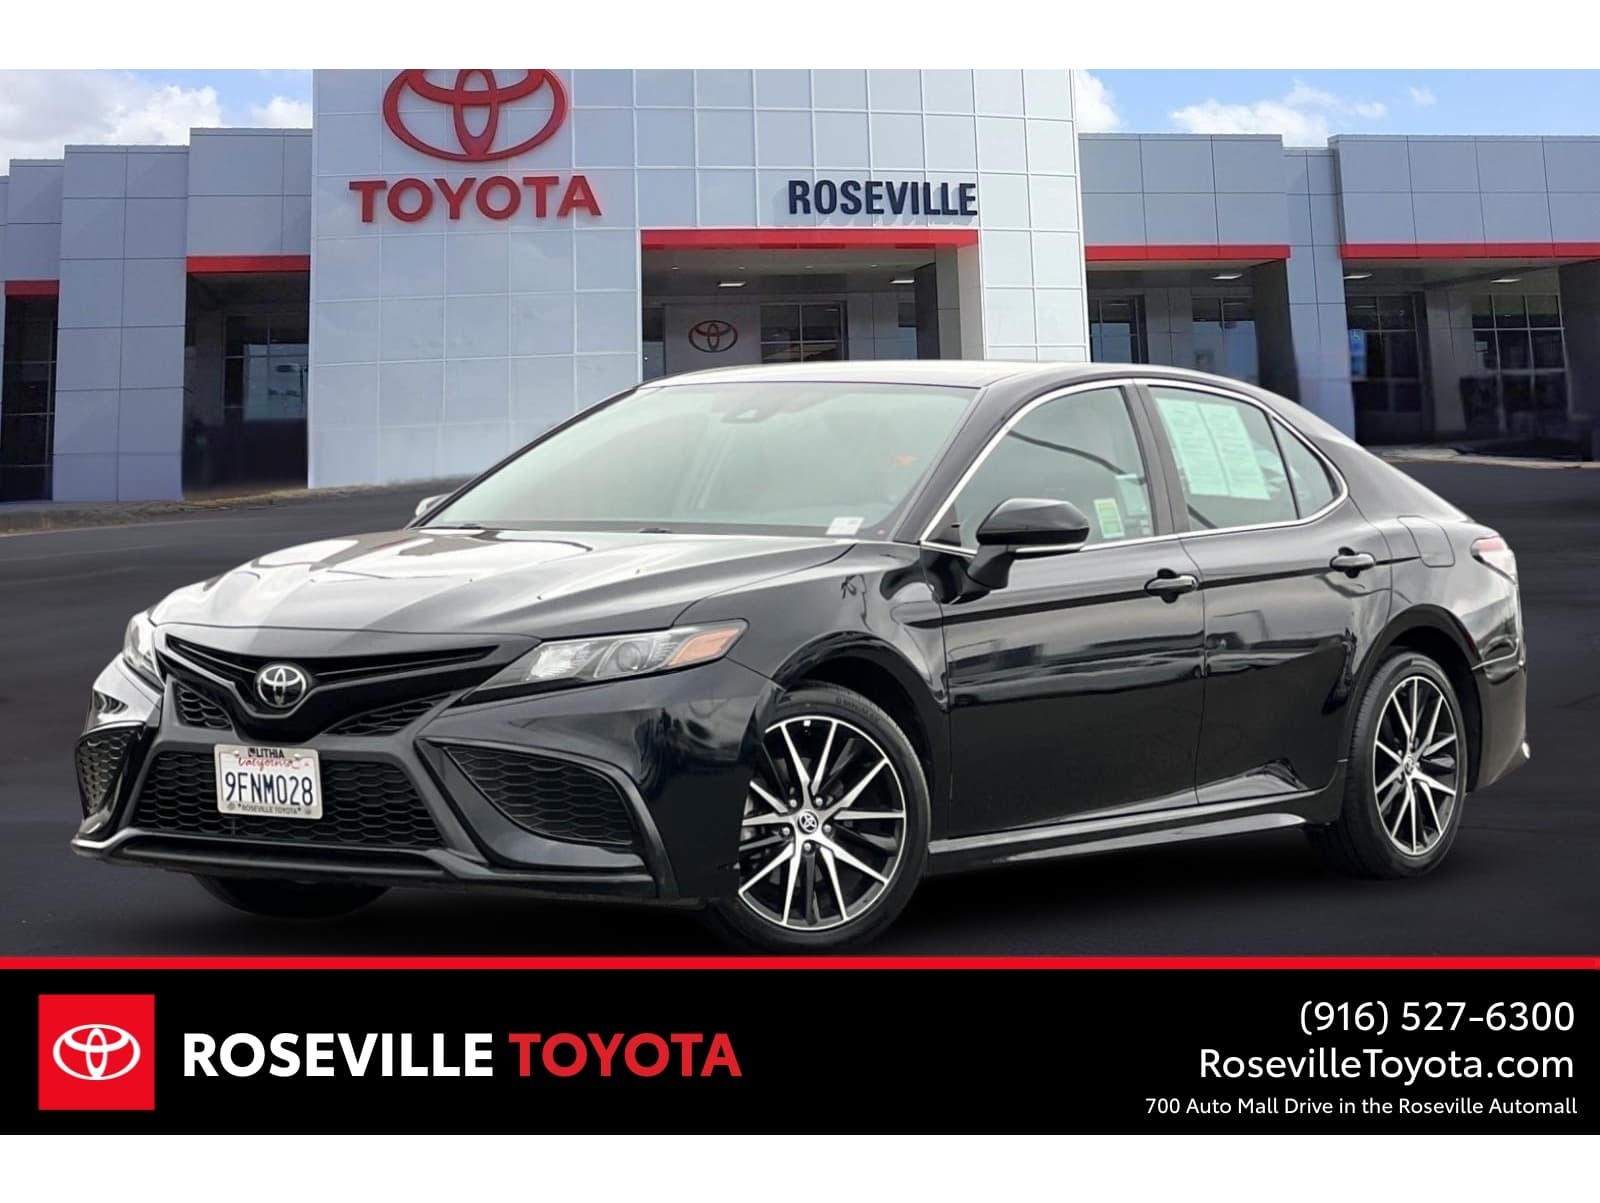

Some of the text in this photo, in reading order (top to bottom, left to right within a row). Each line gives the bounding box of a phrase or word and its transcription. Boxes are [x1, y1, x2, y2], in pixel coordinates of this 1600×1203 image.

[349, 175, 602, 223] TOYOTA
[788, 180, 978, 216] ROSEVILLE
[256, 748, 285, 759] LITHIA
[225, 772, 313, 806] 9FNM028
[241, 804, 299, 815] ROSEVILLE TOYOTA
